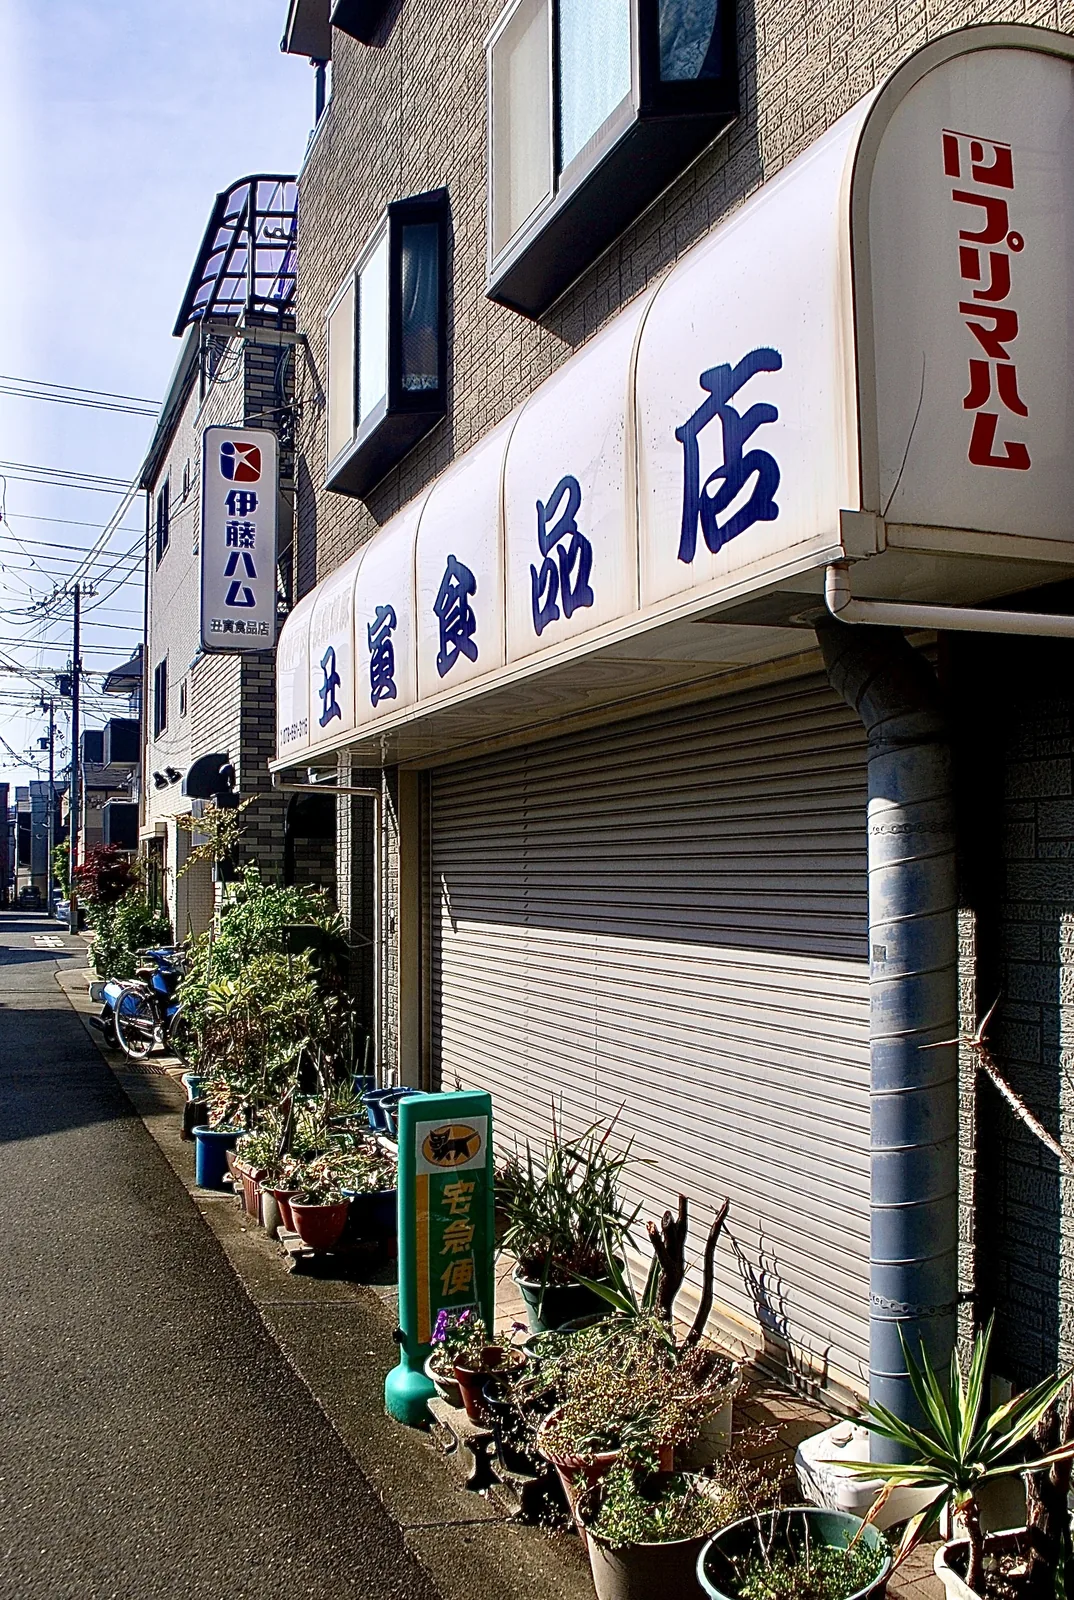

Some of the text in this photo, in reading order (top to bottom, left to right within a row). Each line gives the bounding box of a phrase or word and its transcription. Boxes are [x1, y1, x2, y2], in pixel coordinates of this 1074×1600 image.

[952, 189, 1032, 471] プリマハム
[224, 489, 259, 608] 伊藤ハム
[318, 347, 782, 728] 丑寅食品店
[210, 618, 270, 637] 丑寅食品店
[441, 1180, 475, 1296] 宅急便
